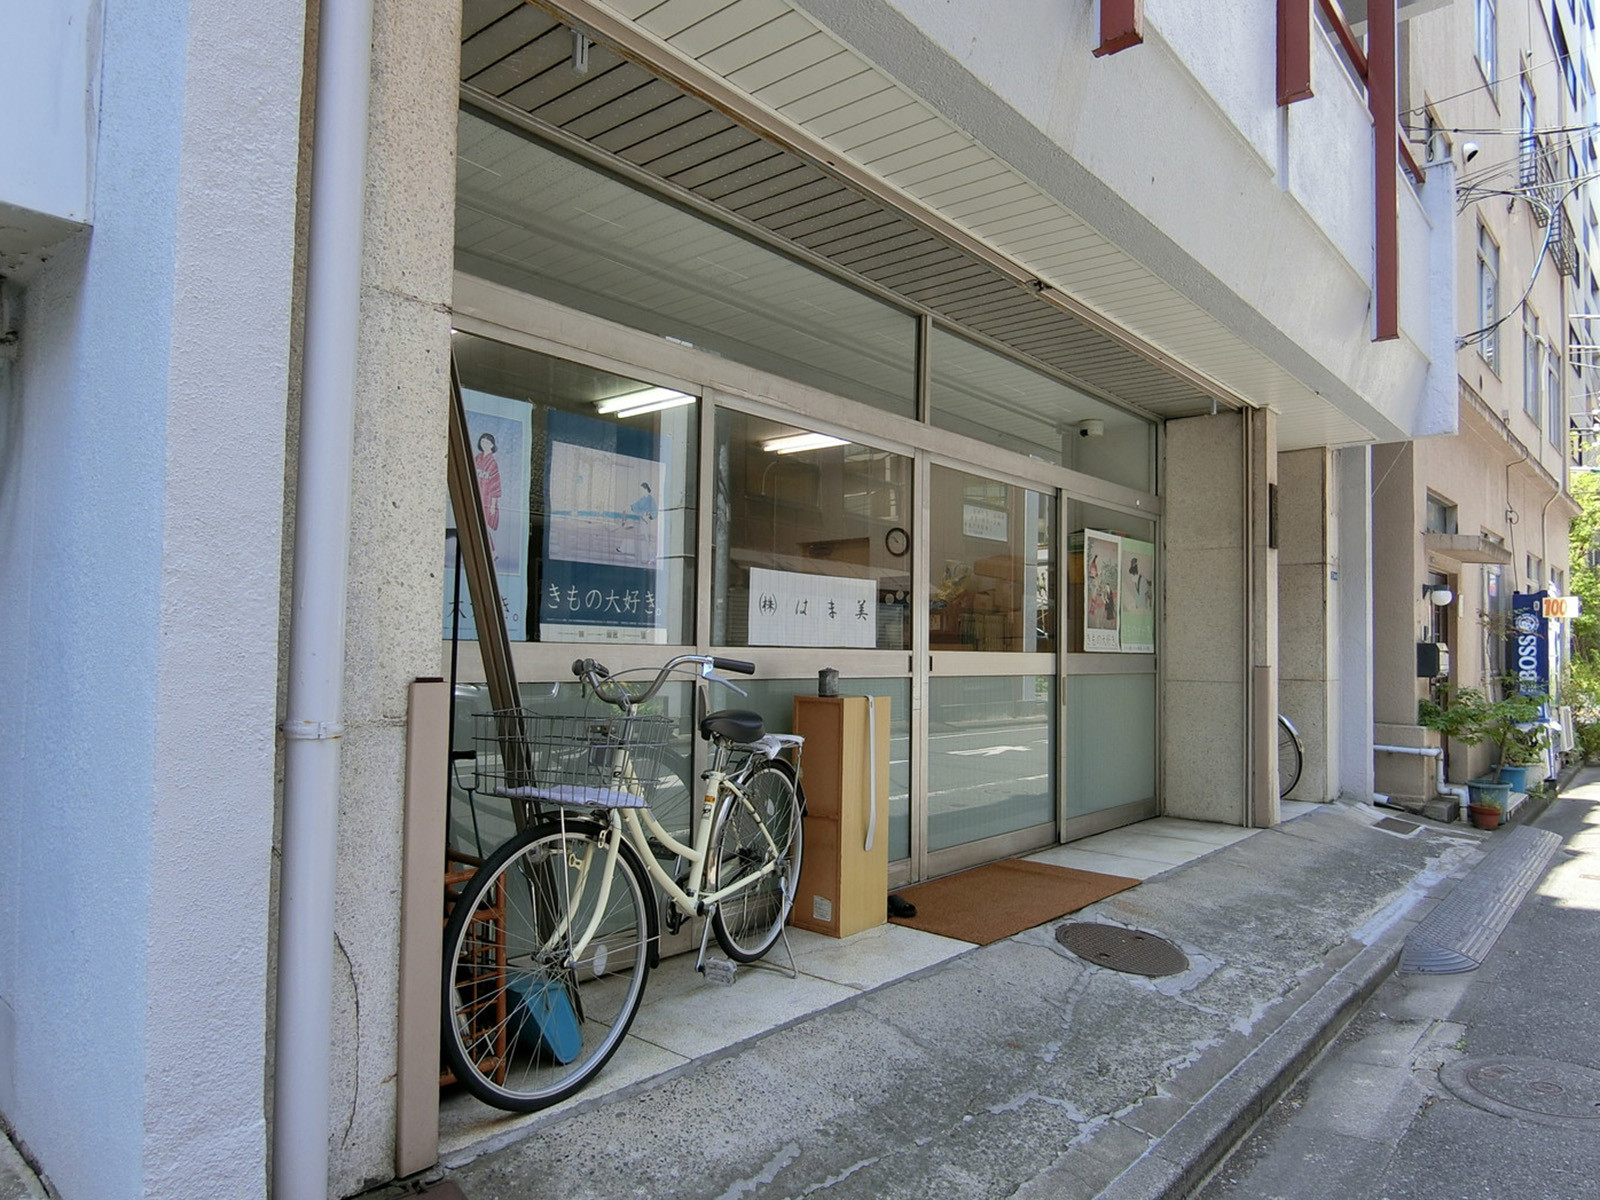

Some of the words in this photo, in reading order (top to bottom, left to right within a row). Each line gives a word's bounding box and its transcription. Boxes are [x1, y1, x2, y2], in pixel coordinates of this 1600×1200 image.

[548, 583, 661, 617] きもの大好き。
[1544, 599, 1567, 616] 100
[1518, 635, 1537, 682] BOSS
